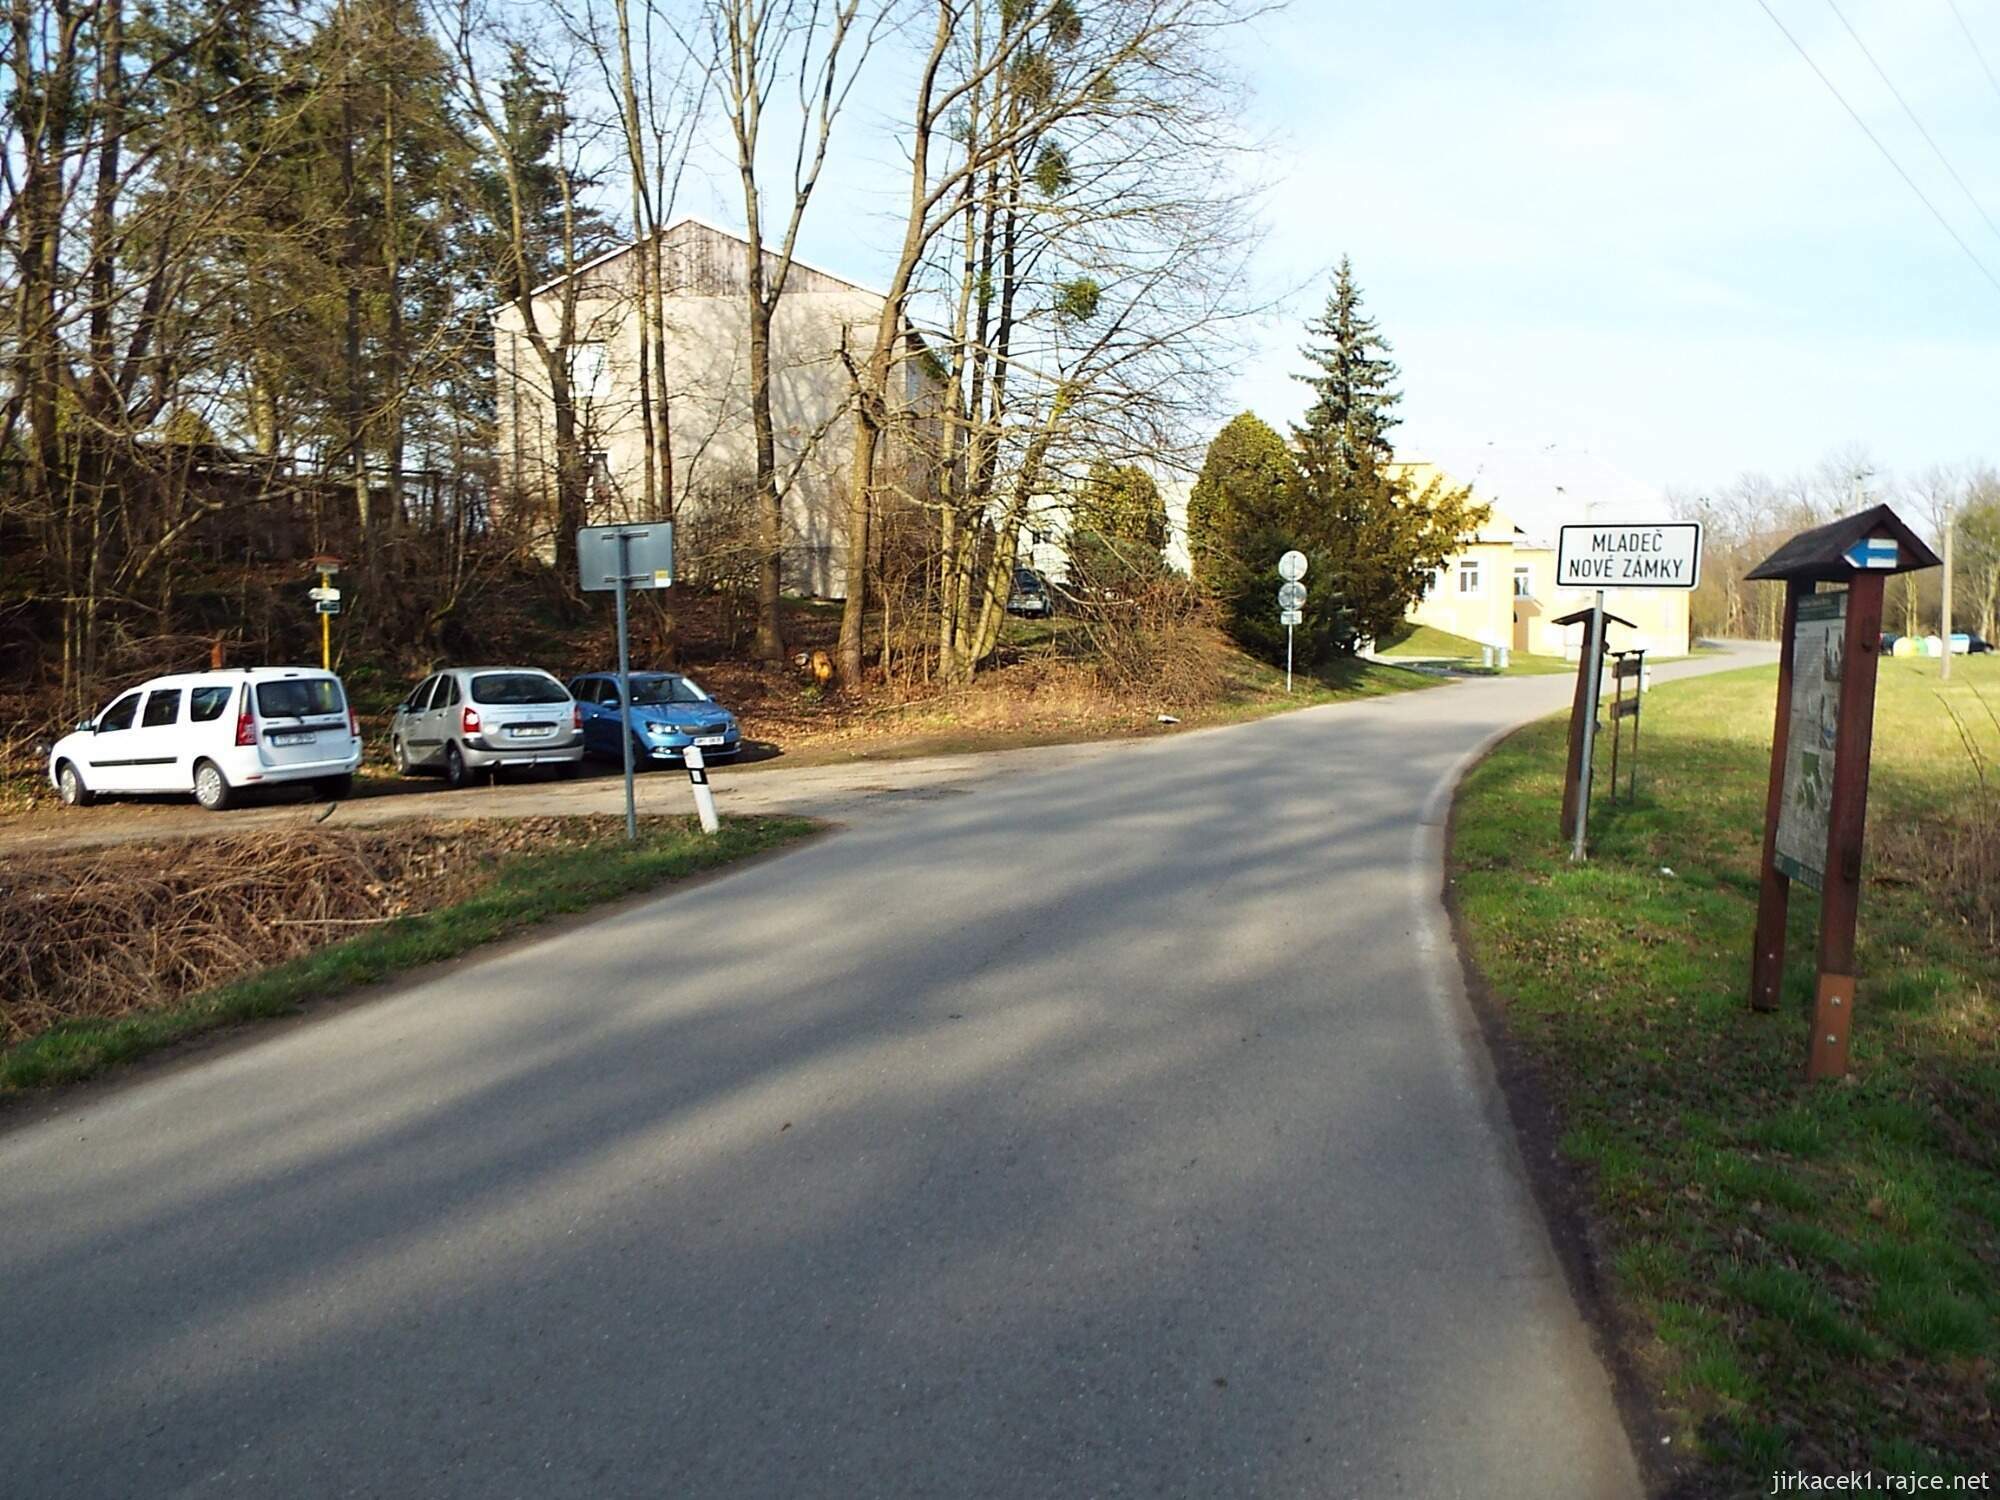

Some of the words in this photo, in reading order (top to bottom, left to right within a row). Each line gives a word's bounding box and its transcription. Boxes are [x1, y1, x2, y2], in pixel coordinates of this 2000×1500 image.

[1592, 528, 1663, 553] MLADEČ
[1569, 555, 1614, 578] NOVÉ
[1622, 555, 1684, 578] ZÁMKY
